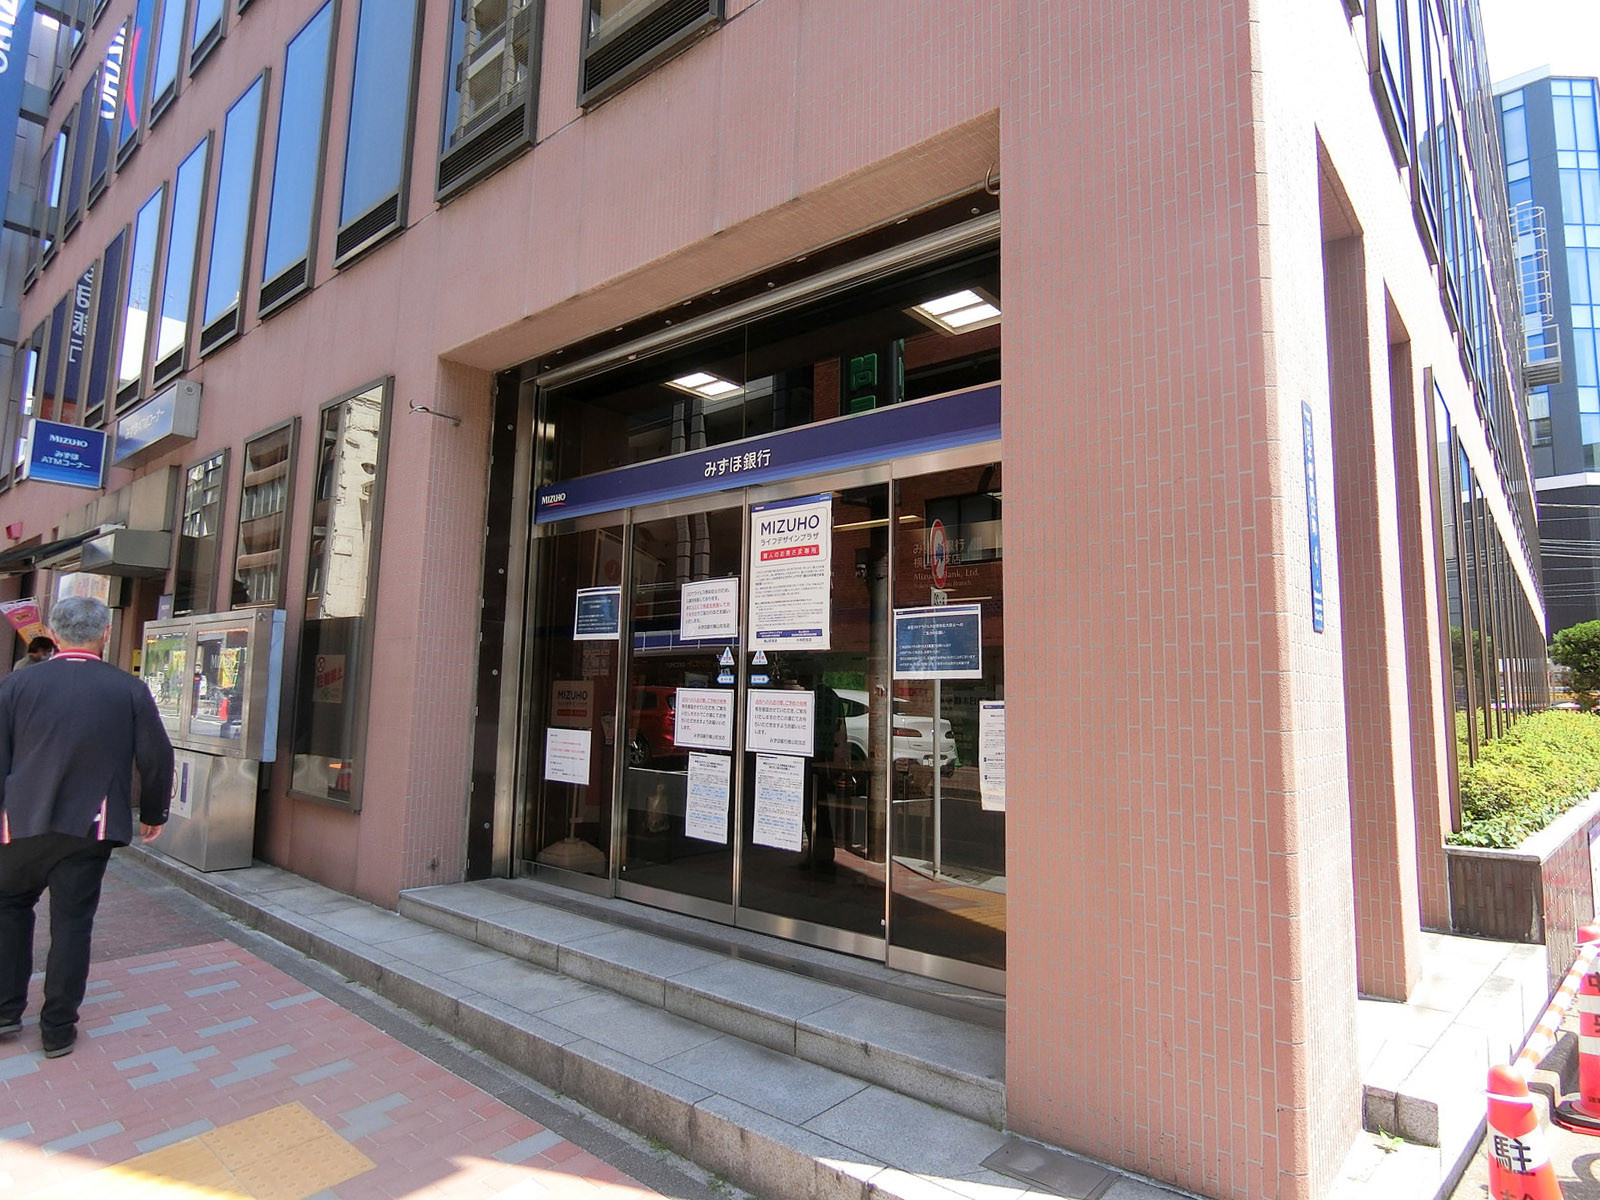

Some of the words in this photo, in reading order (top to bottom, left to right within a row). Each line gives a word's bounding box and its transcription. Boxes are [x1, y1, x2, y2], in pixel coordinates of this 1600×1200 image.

[49, 434, 89, 448] MIZUHO
[54, 450, 79, 460] みずほ
[40, 456, 92, 469] ATMコーナー
[704, 449, 771, 477] みずほ銀行
[541, 492, 566, 505] MIZUHO
[760, 514, 820, 536] MIZUHO
[761, 532, 819, 546] ライフデザインプラザ
[557, 690, 588, 700] MIZUHO
